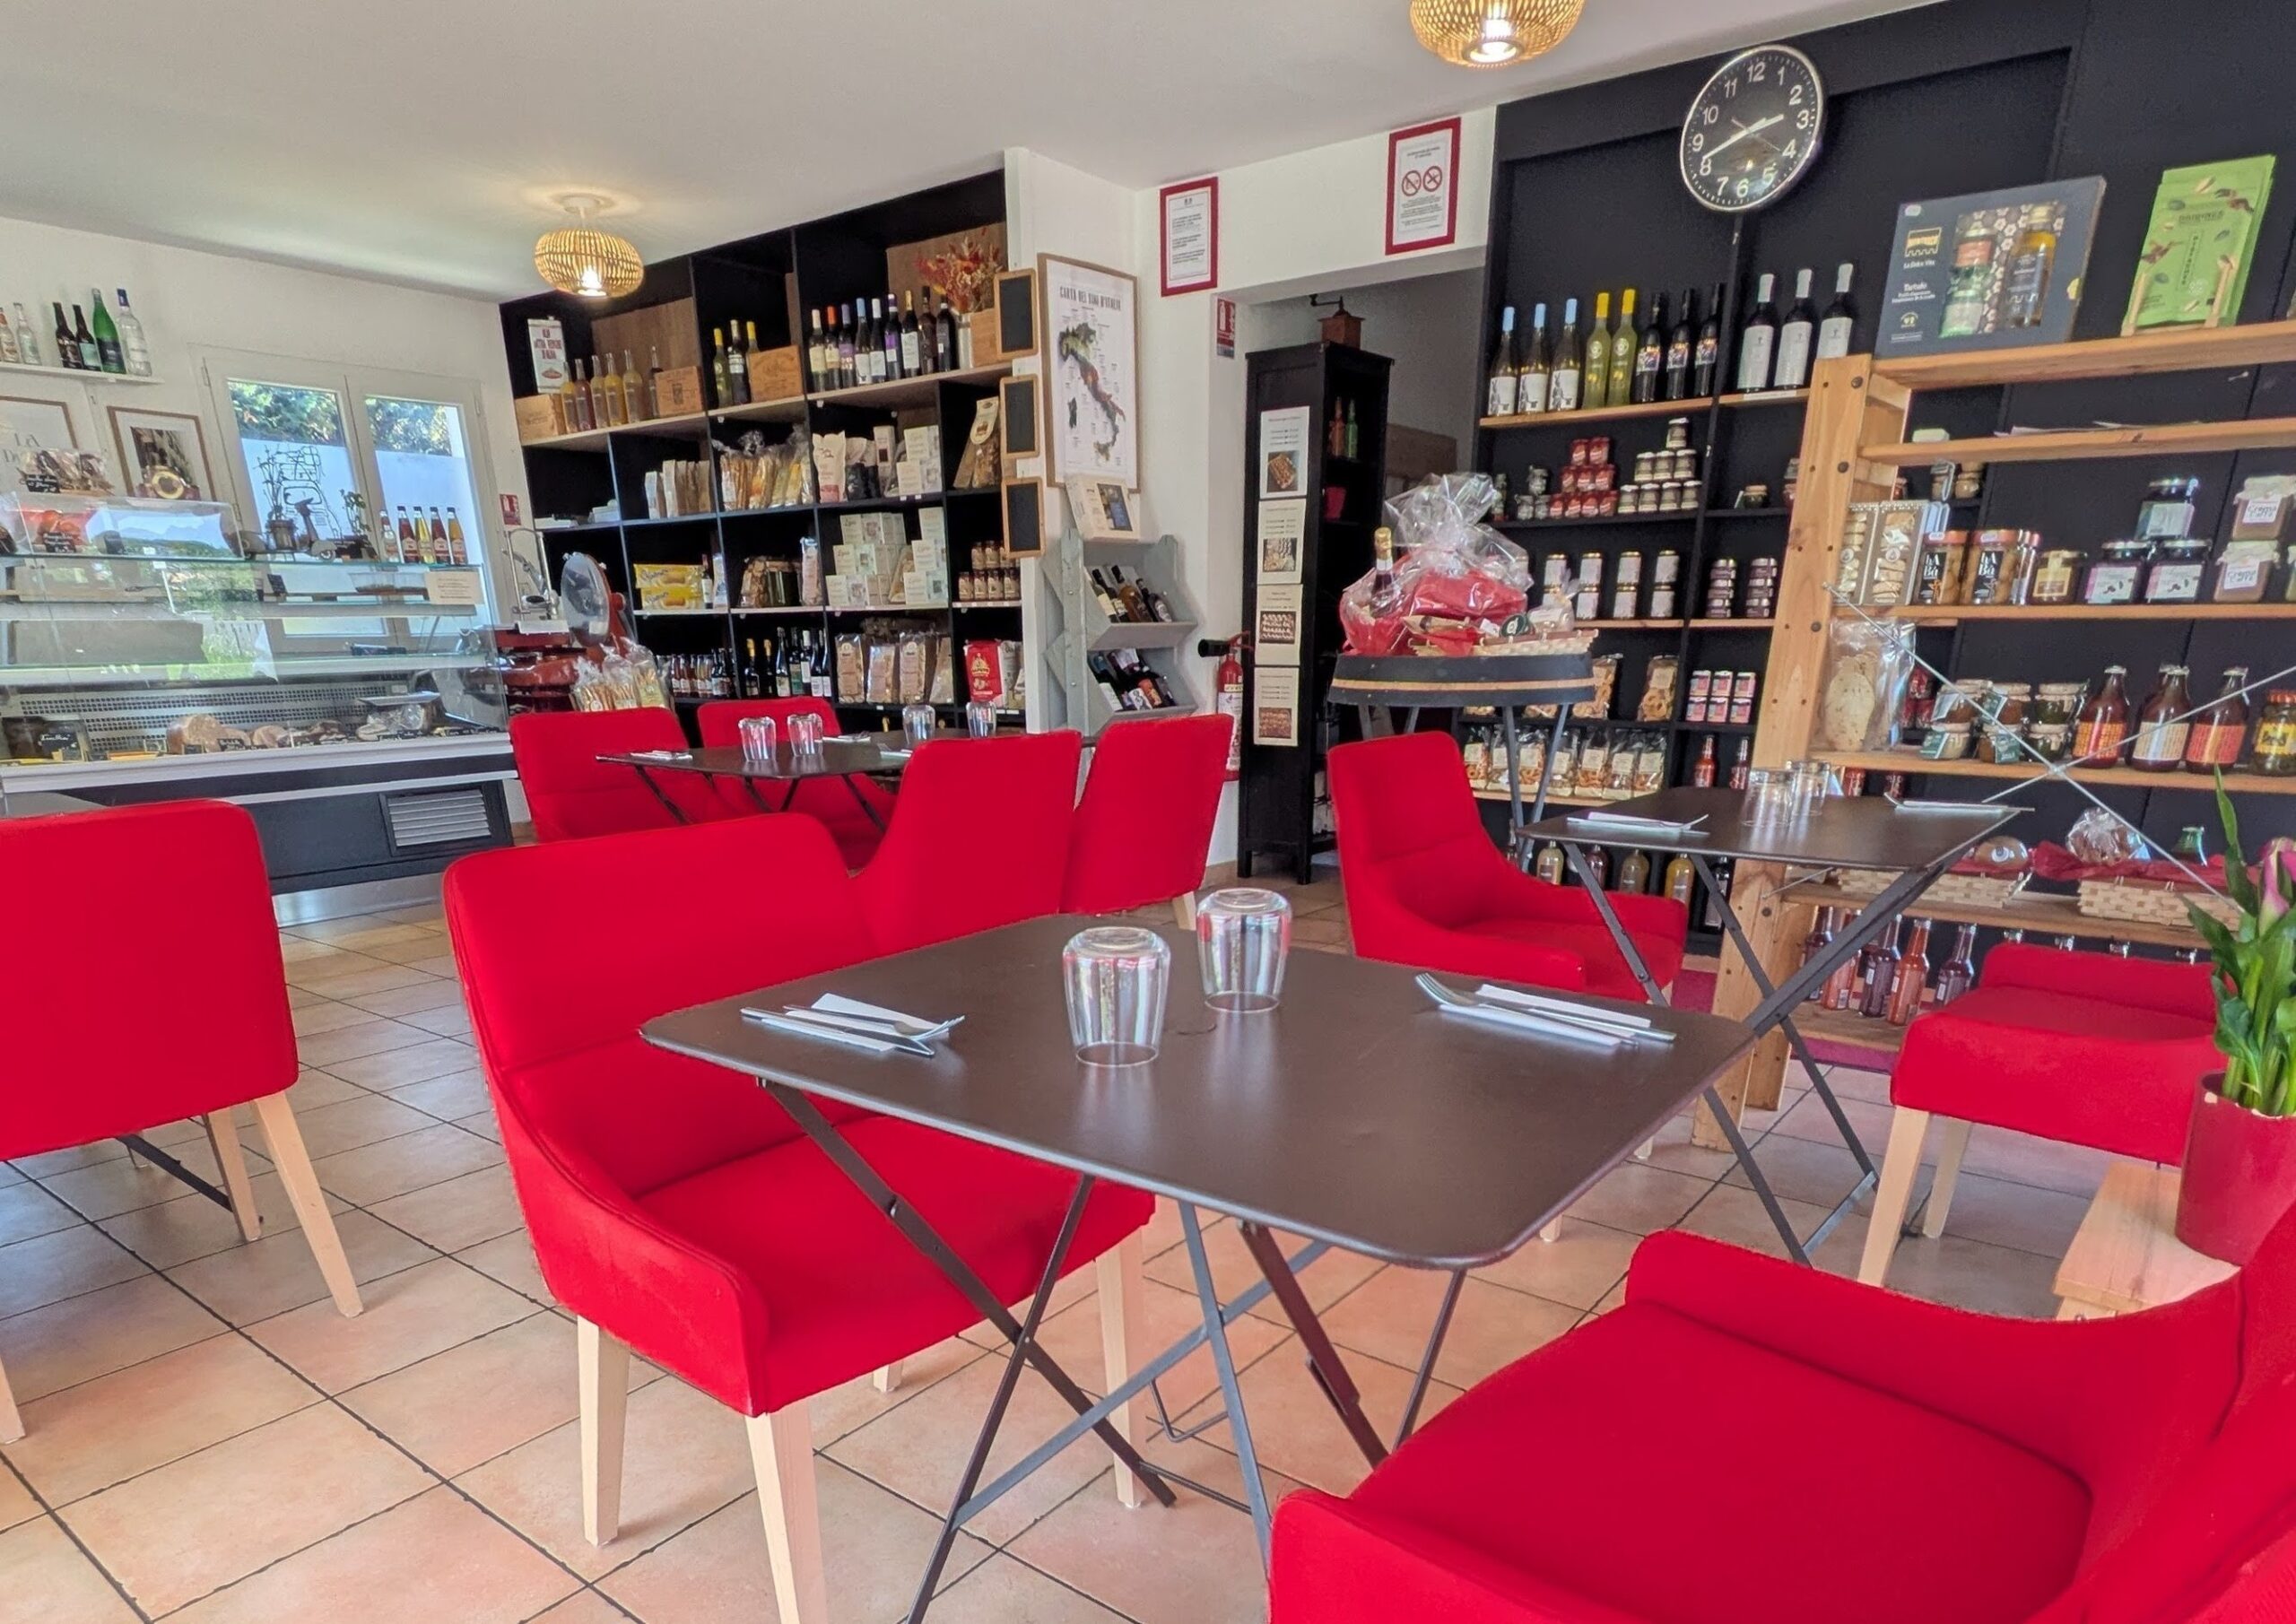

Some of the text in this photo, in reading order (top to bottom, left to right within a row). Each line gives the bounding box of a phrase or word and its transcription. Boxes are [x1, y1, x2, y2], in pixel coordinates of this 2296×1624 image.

[1747, 61, 1766, 83] 12
[1777, 65, 1786, 85] 1
[1724, 77, 1737, 98] 11
[1788, 84, 1803, 105] 2
[1701, 105, 1719, 126] 10
[1796, 109, 1810, 129] 3
[1692, 133, 1704, 152] 9
[1782, 138, 1796, 159] 4
[1700, 157, 1712, 176] 8
[1762, 164, 1779, 185] 5
[1717, 176, 1729, 196] 7
[1736, 178, 1749, 197] 6
[1059, 286, 1076, 300] CARTA
